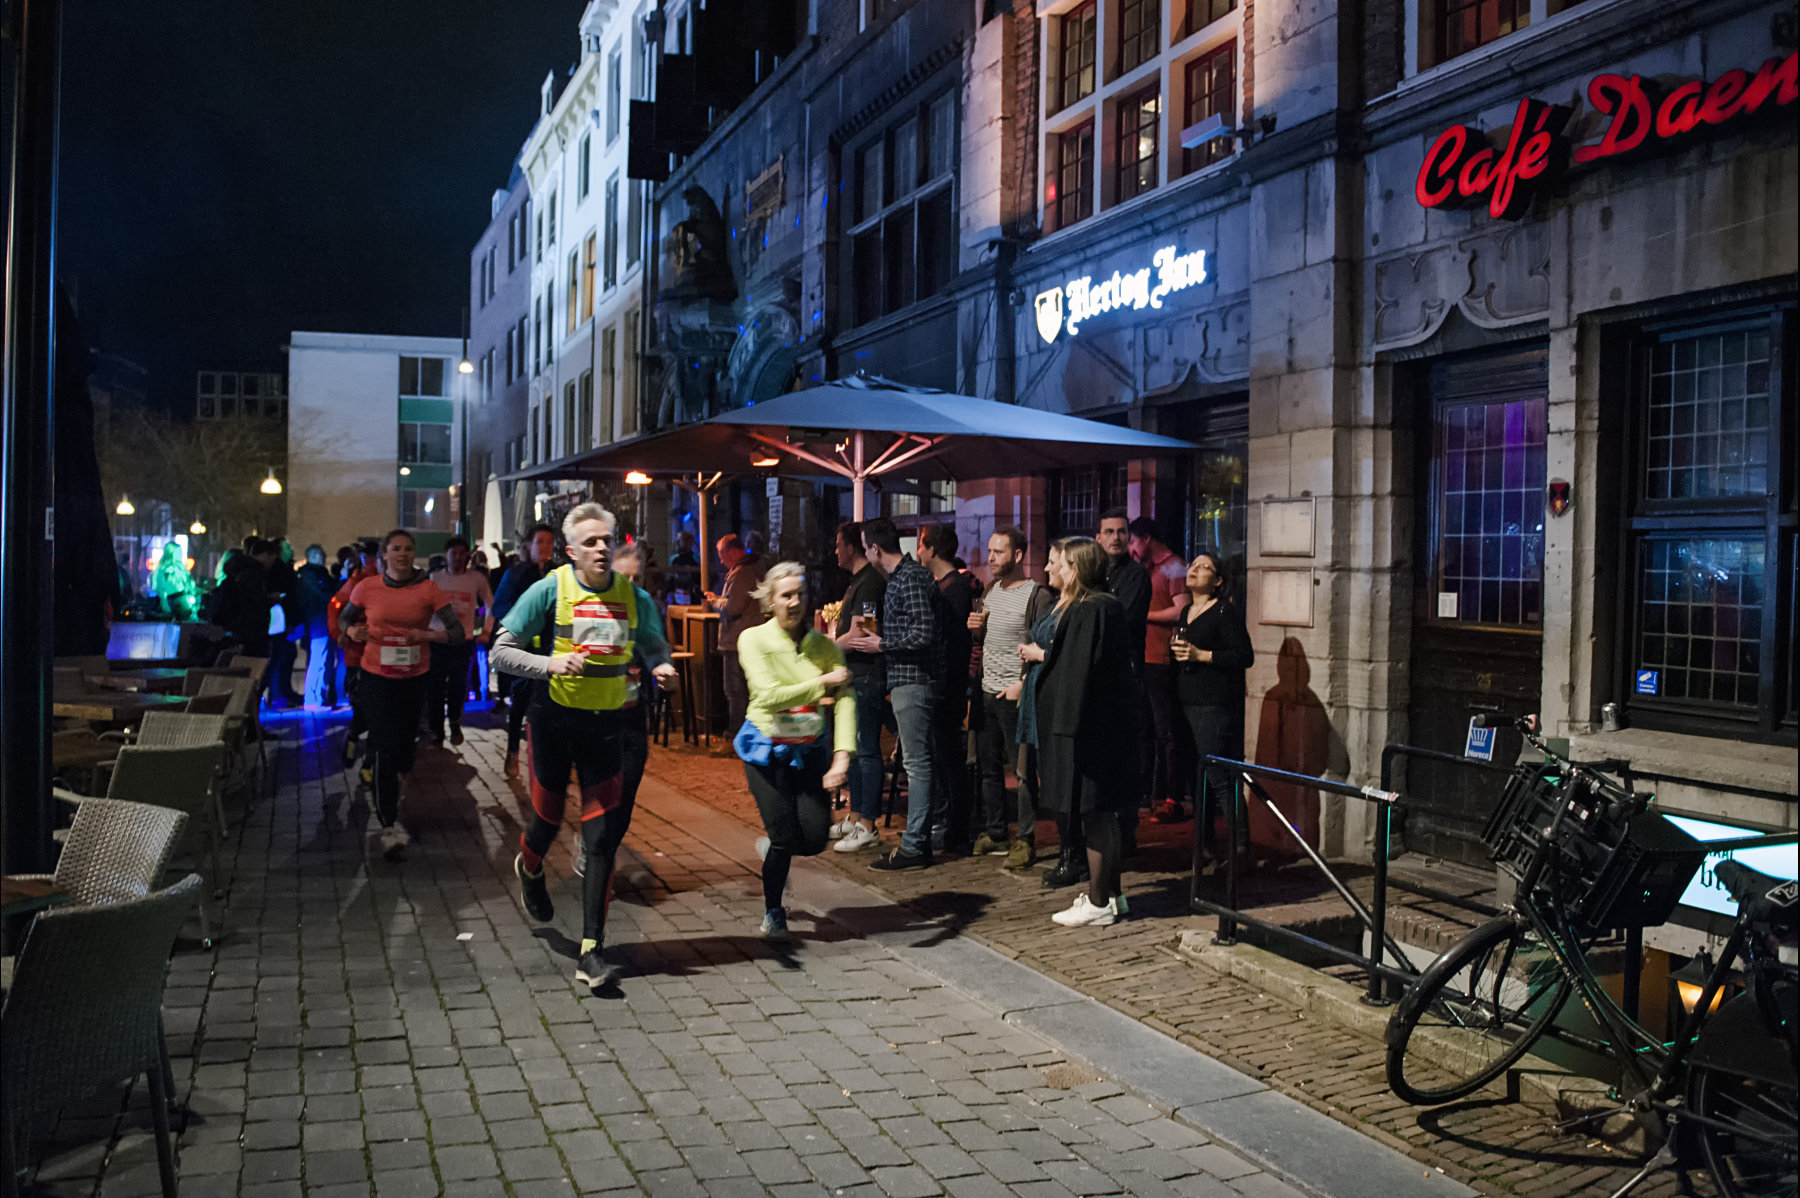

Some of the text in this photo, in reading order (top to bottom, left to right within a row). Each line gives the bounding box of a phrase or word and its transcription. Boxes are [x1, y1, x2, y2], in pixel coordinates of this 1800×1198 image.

[1415, 97, 1556, 219] Café
[1066, 245, 1206, 335] Hertog Jan
[1467, 749, 1489, 759] Horeca
